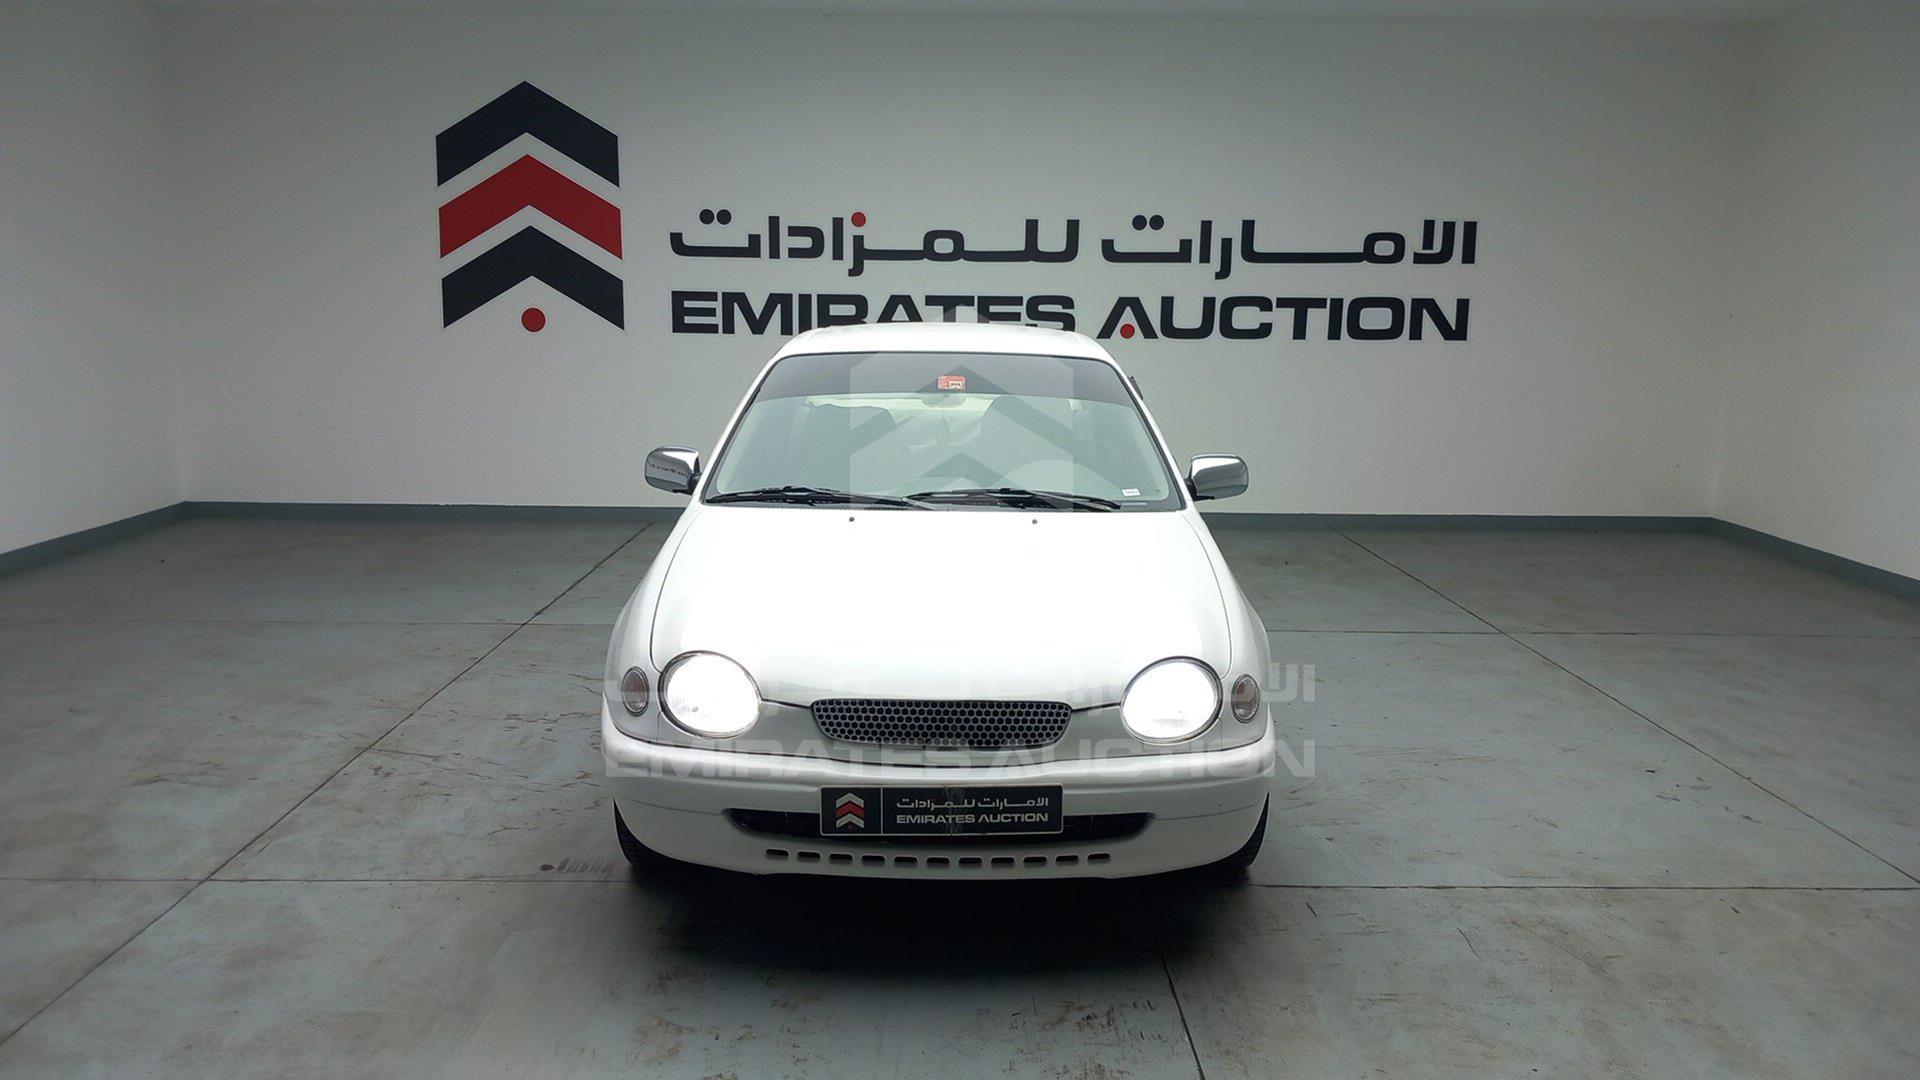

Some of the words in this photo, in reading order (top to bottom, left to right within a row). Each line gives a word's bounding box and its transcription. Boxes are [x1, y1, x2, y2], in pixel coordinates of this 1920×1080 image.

[669, 208, 1079, 277] للمزادات
[671, 290, 1077, 337] EMIRATES
[1096, 295, 1470, 341] AUCTION
[896, 814, 975, 824] EMIRATES
[977, 812, 1049, 823] AUCTION
